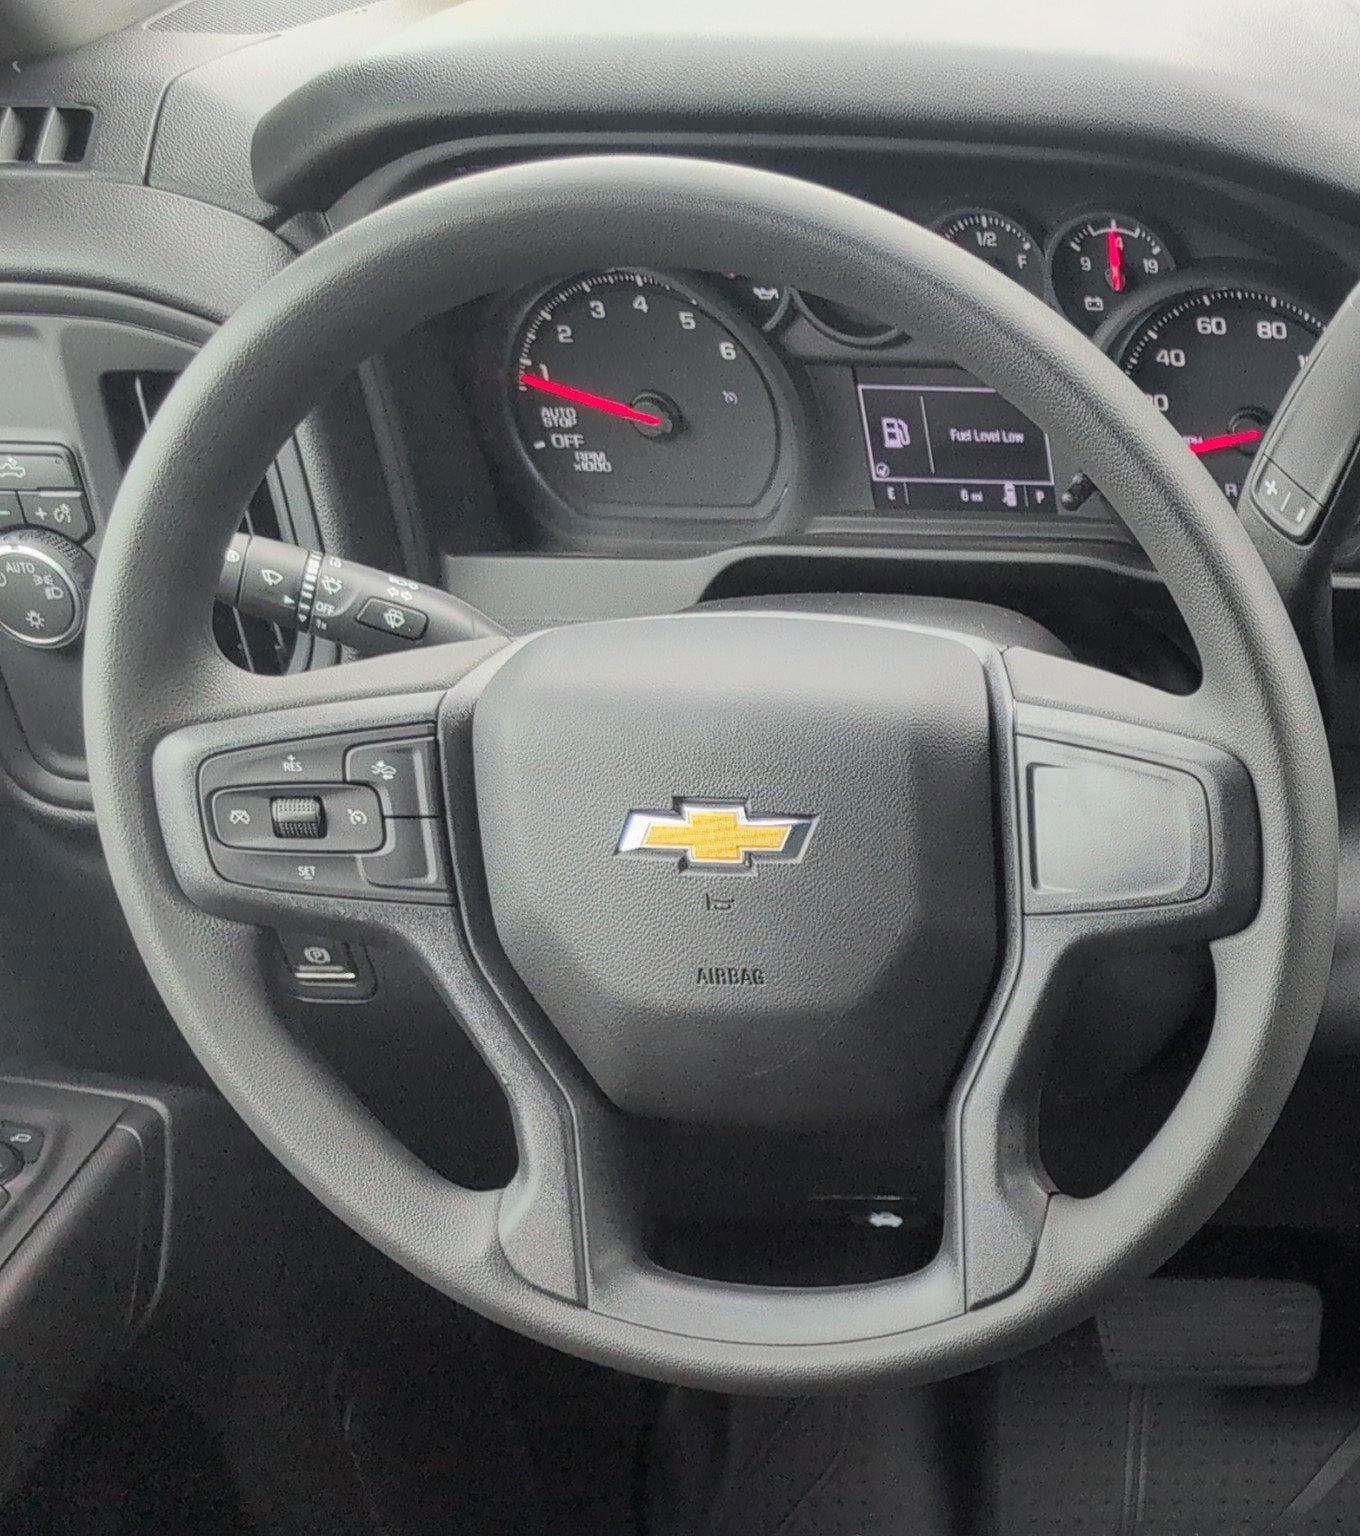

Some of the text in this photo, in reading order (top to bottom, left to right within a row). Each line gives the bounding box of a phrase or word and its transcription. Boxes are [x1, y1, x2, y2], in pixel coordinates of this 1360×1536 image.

[976, 231, 998, 247] 1/2
[1017, 253, 1028, 269] F
[1080, 256, 1091, 271] 9
[1143, 258, 1158, 274] 19
[589, 300, 606, 319] 3
[632, 295, 649, 314] 4
[678, 311, 696, 330] 5
[1196, 317, 1227, 335] 60
[556, 325, 574, 344] 2
[1256, 321, 1288, 339] 80
[719, 341, 737, 360] 6
[1155, 348, 1186, 367] 40
[540, 407, 577, 419] AUTO
[551, 433, 584, 449] OFF
[950, 428, 1024, 444] Fuel Level Low
[574, 451, 607, 464] RPM
[887, 486, 896, 500] E
[1035, 490, 1045, 503] P
[6, 561, 35, 574] AUTO
[315, 602, 335, 616] OFF
[282, 762, 303, 772] RES
[298, 865, 316, 877] SET
[696, 967, 764, 985] AIRBAG
